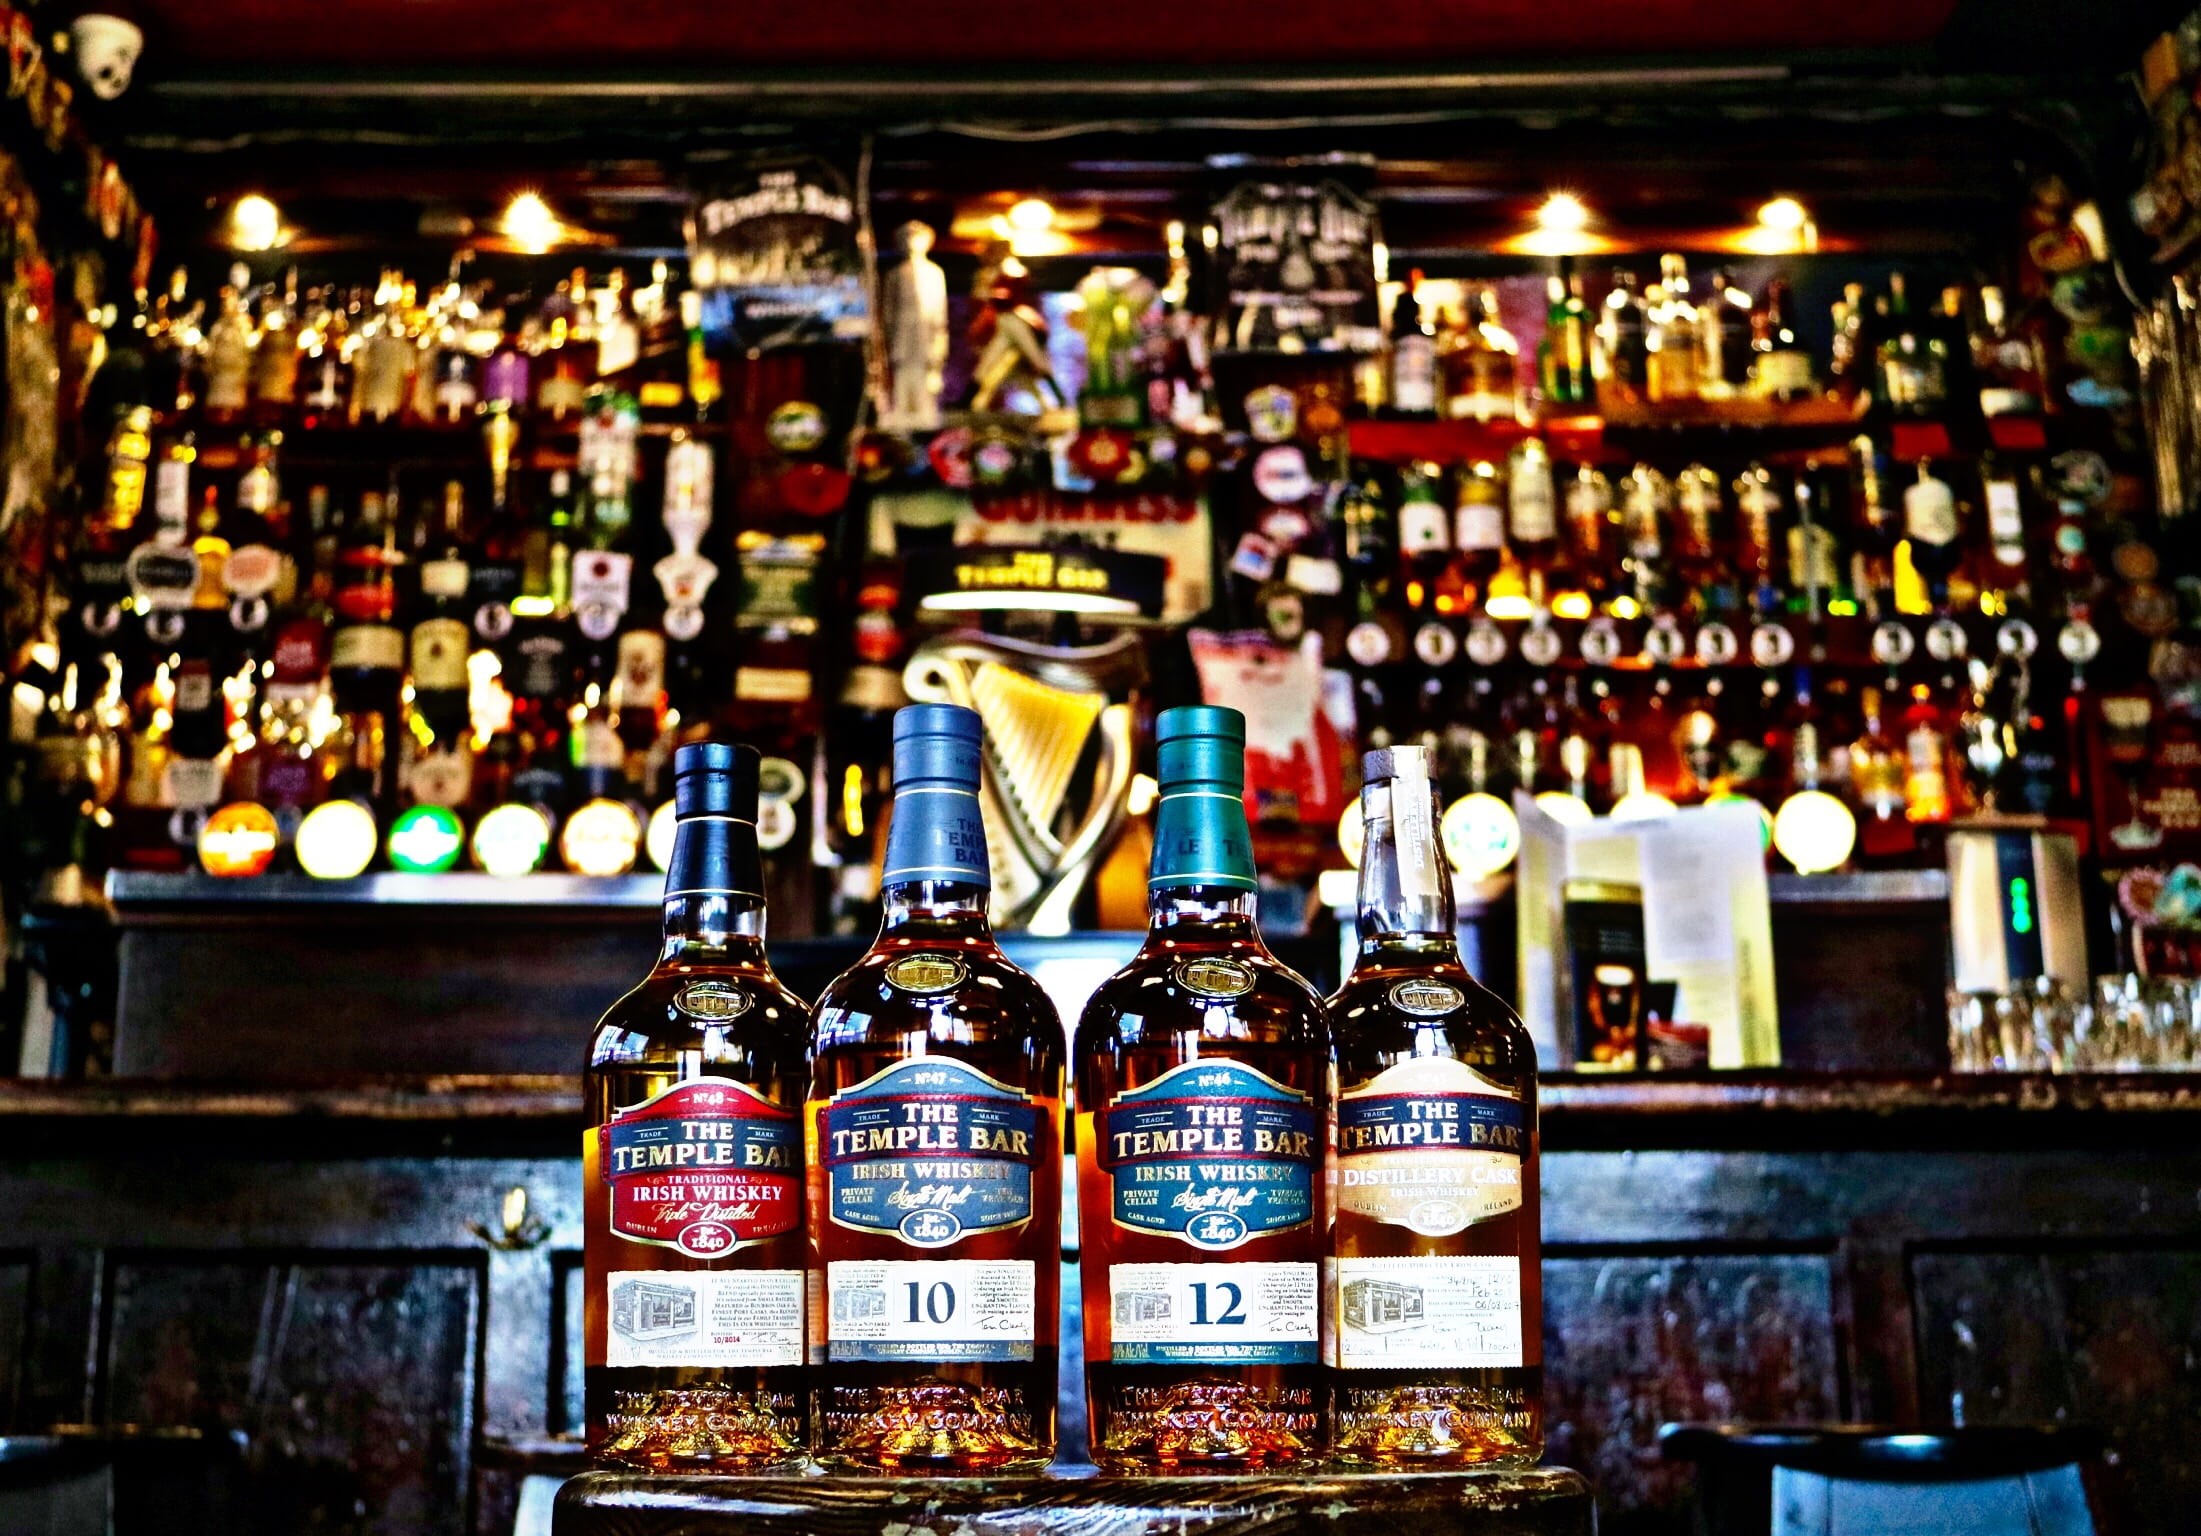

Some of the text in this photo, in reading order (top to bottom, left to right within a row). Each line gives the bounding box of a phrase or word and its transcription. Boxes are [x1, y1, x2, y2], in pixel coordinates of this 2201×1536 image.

[859, 1113, 881, 1121] TRADE
[902, 1103, 958, 1123] THE
[1186, 1105, 1243, 1125] THE
[1363, 1110, 1387, 1118] TRADE
[1407, 1100, 1459, 1119] THE
[1141, 1116, 1165, 1124] TRADE
[640, 1131, 662, 1139] TRADE
[681, 1122, 734, 1140] THE
[1339, 1122, 1520, 1151] TEMPLE BAR
[833, 1126, 1030, 1156] TEMPLE BAR
[1113, 1129, 1311, 1158] TEMPLE BAR
[614, 1143, 734, 1171] TEMPLE
[667, 1175, 748, 1184] TRADITIONAL
[853, 1163, 1010, 1180] IRISH WHISKEY
[1135, 1165, 1293, 1182] IRISH WHISKEY
[1343, 1166, 1518, 1187] DISTILLERY CASK
[633, 1185, 783, 1201] IRISH WHISKEY
[1123, 1189, 1159, 1198] PRIVATE
[1124, 1197, 1158, 1206] CELLAR
[651, 1202, 761, 1223] Triple Distilled
[914, 1220, 949, 1239] 1840
[1199, 1223, 1236, 1242] 1840
[691, 1231, 725, 1250] 1840
[902, 1281, 956, 1324] 10
[1189, 1282, 1247, 1325] 12
[713, 1336, 741, 1345] 10/2014
[1220, 1410, 1319, 1430] COMPANY
